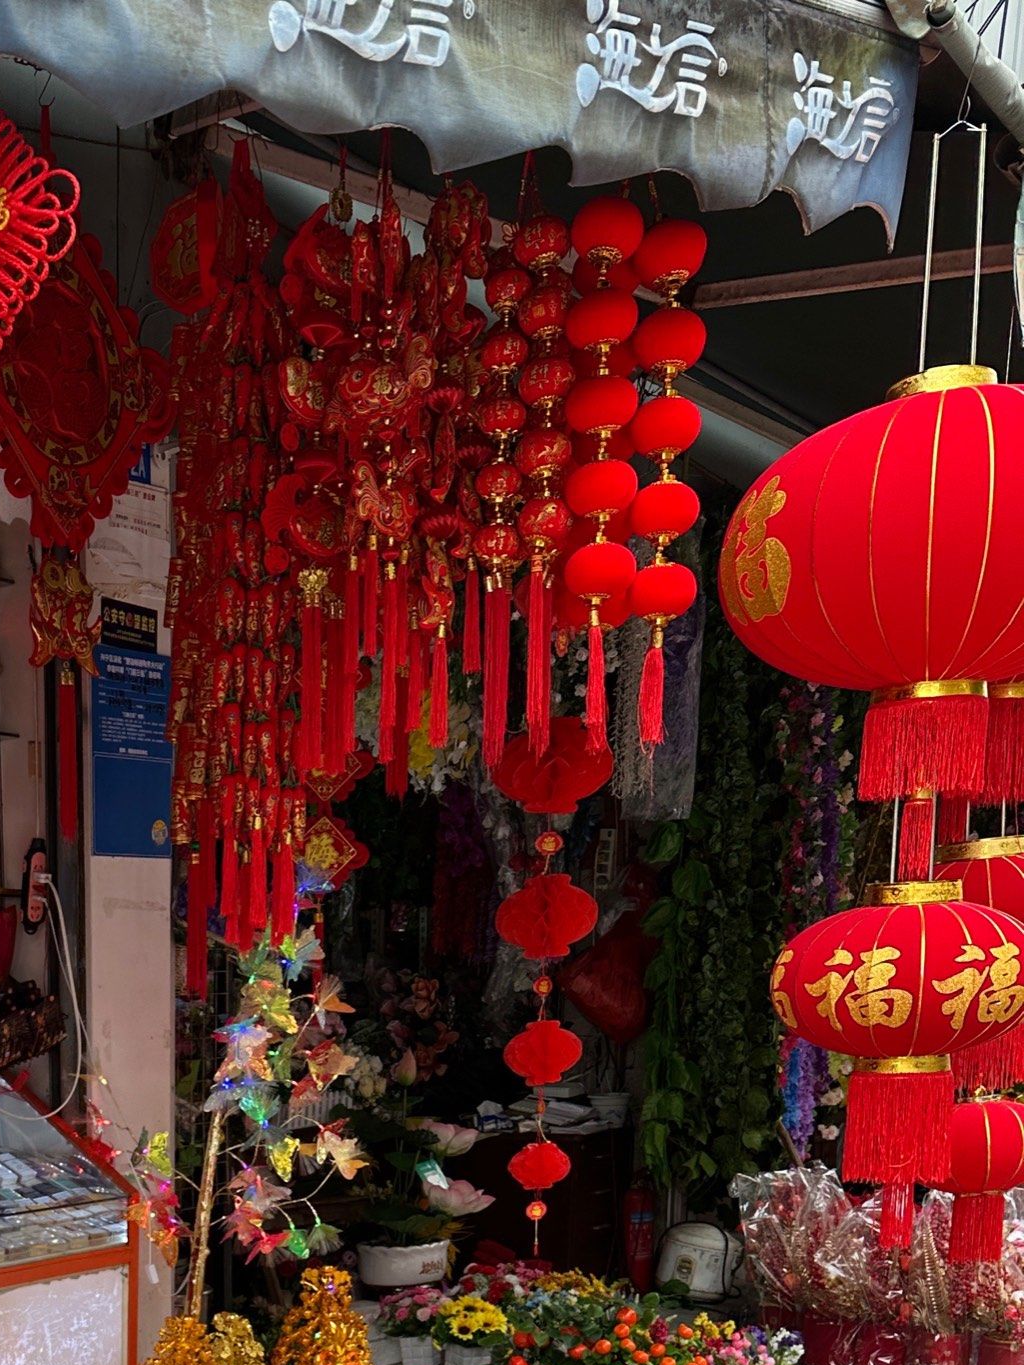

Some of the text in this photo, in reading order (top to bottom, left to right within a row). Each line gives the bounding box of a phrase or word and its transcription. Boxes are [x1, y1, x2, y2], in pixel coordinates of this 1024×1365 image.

[576, 0, 719, 118] 海信
[787, 51, 896, 163] 海信
[806, 944, 1024, 1031] 福 福
